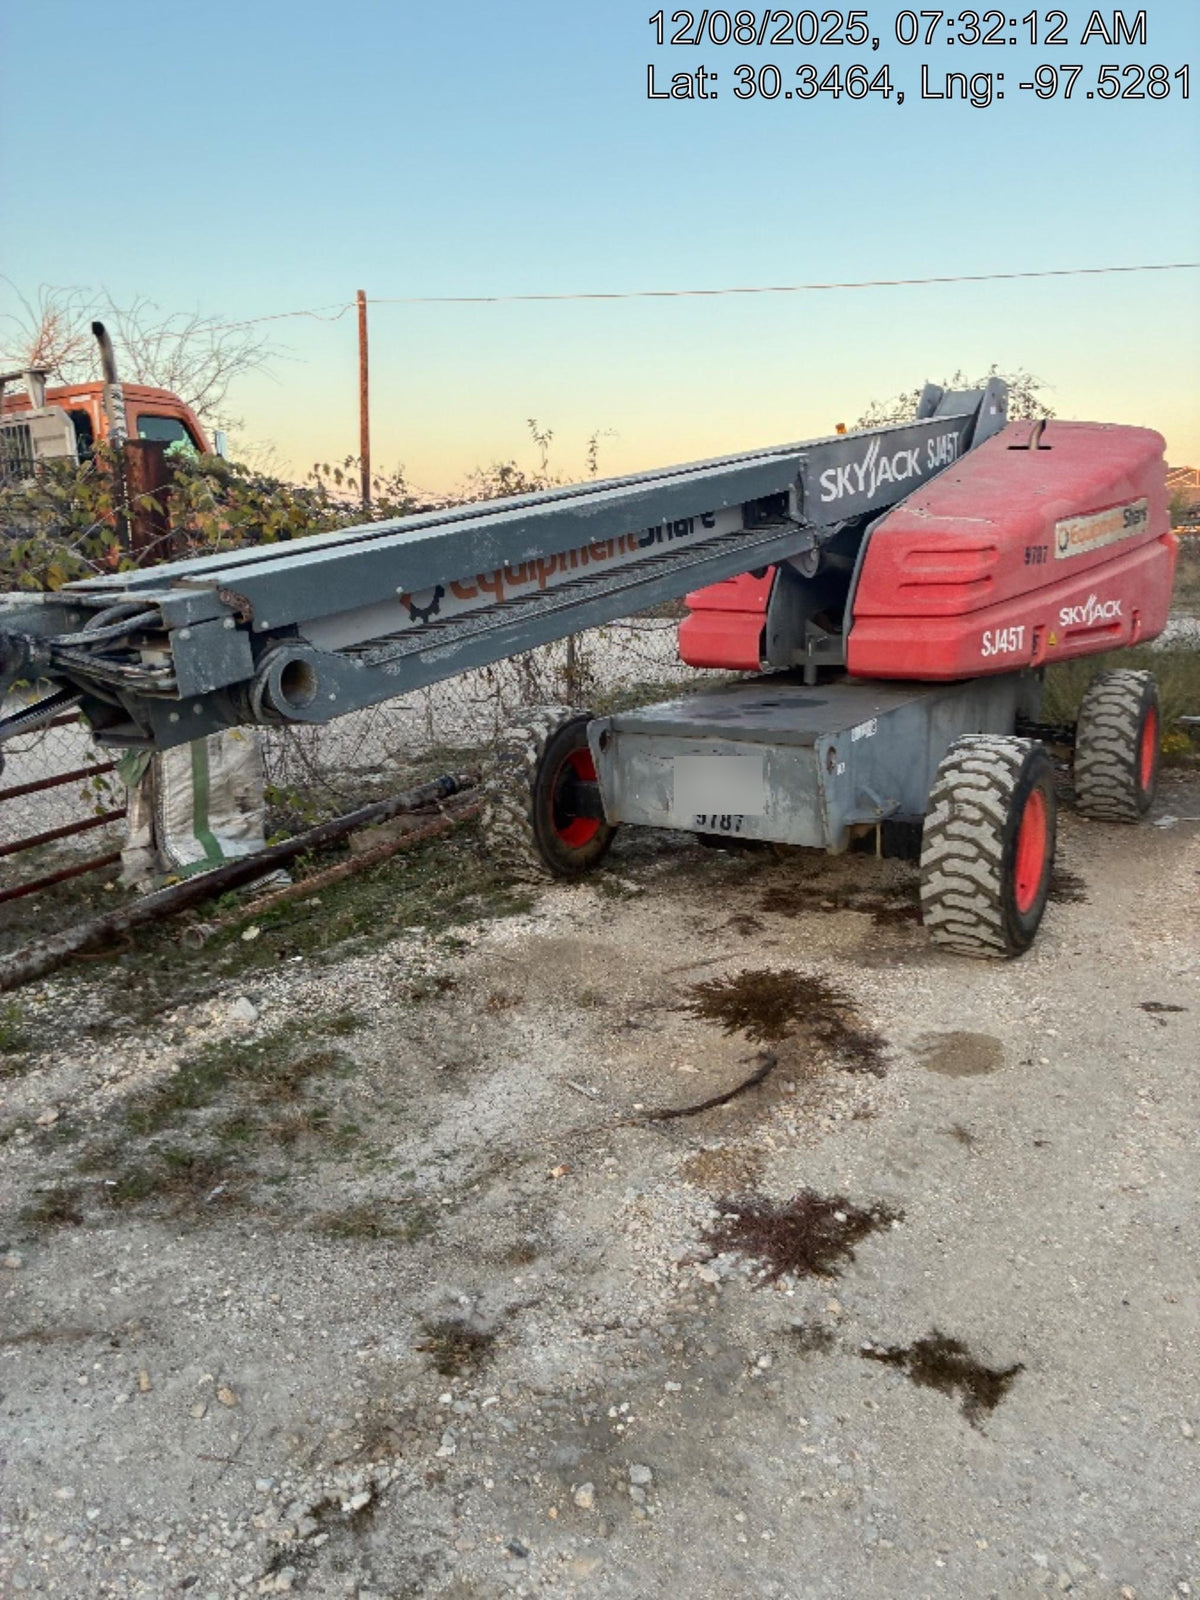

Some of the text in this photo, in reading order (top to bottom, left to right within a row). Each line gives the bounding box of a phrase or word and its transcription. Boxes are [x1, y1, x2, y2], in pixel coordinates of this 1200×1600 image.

[819, 431, 960, 502] SKYJACK SJ45T
[1059, 593, 1123, 627] SKYJACK
[981, 625, 1026, 657] SJ45T
